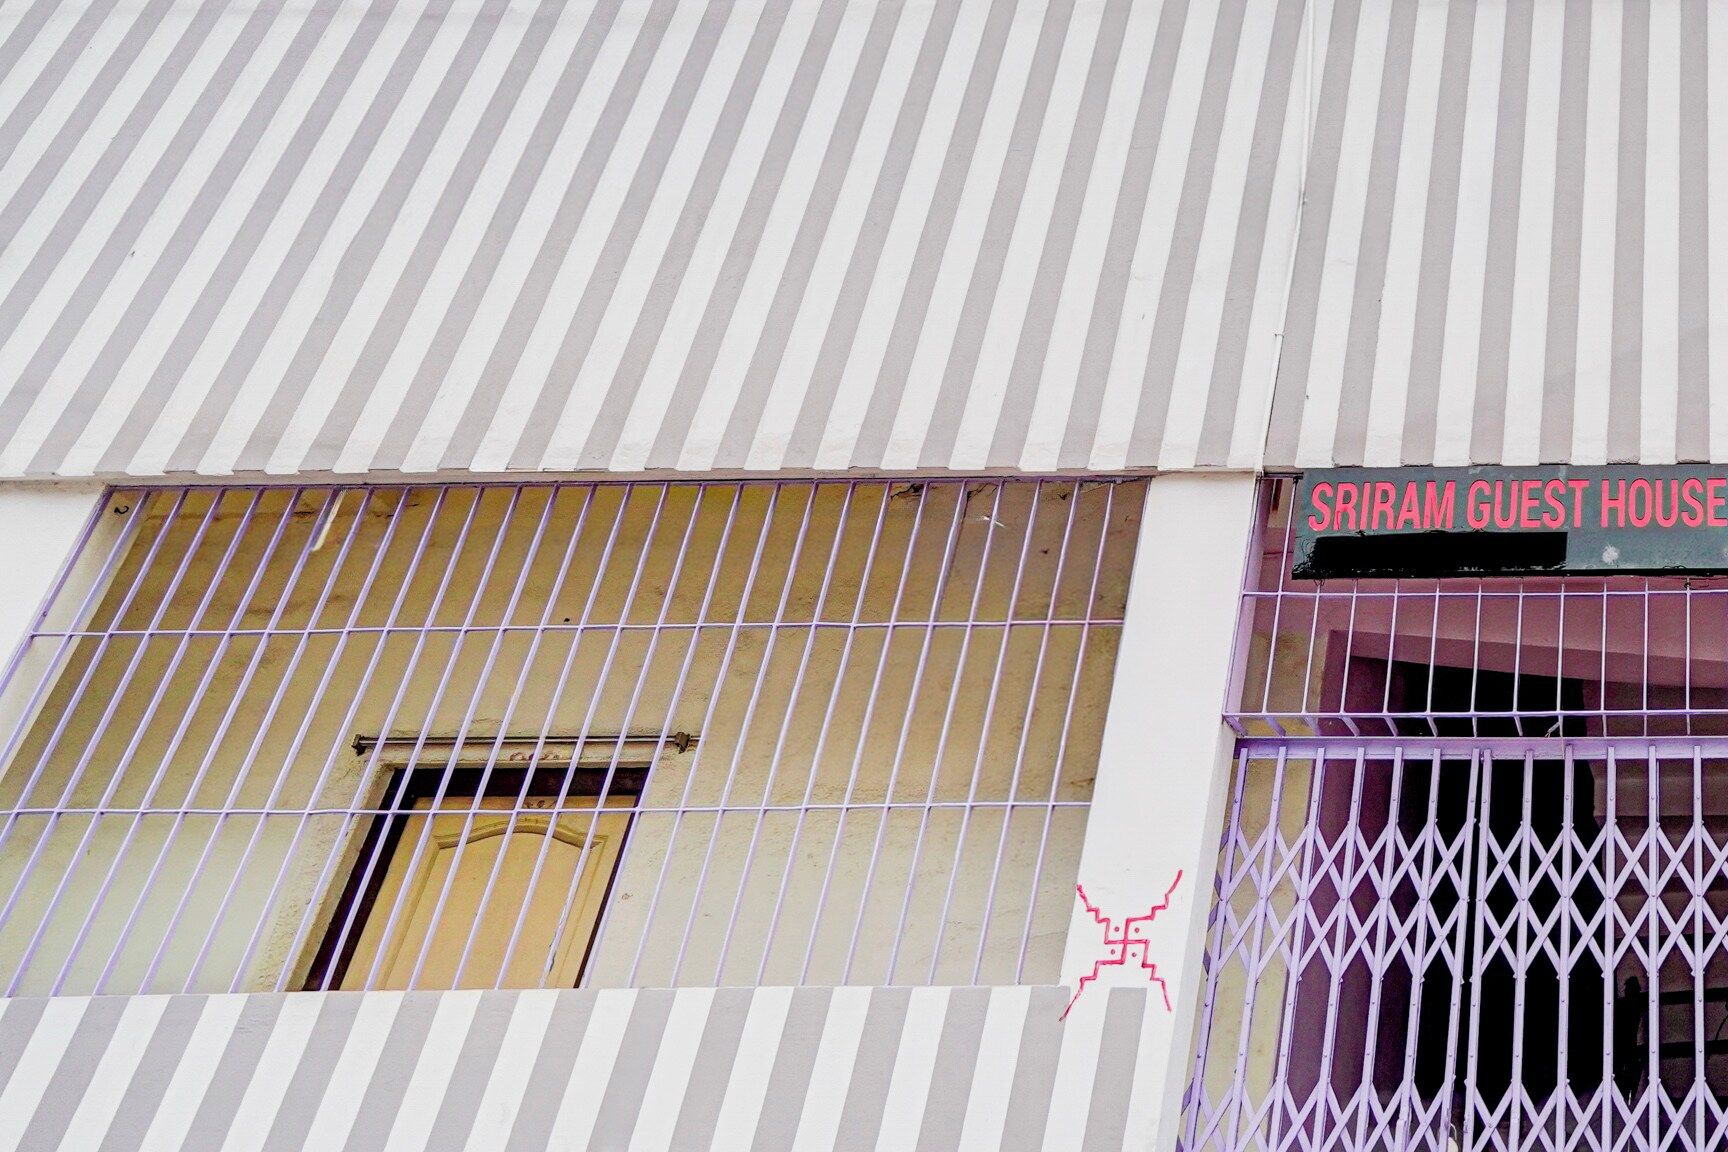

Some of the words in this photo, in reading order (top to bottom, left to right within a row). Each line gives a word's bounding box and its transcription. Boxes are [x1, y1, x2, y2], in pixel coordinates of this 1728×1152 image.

[1308, 479, 1456, 531] SRIRAM
[1466, 478, 1590, 529] GUEST
[1600, 477, 1728, 527] HOUSE
